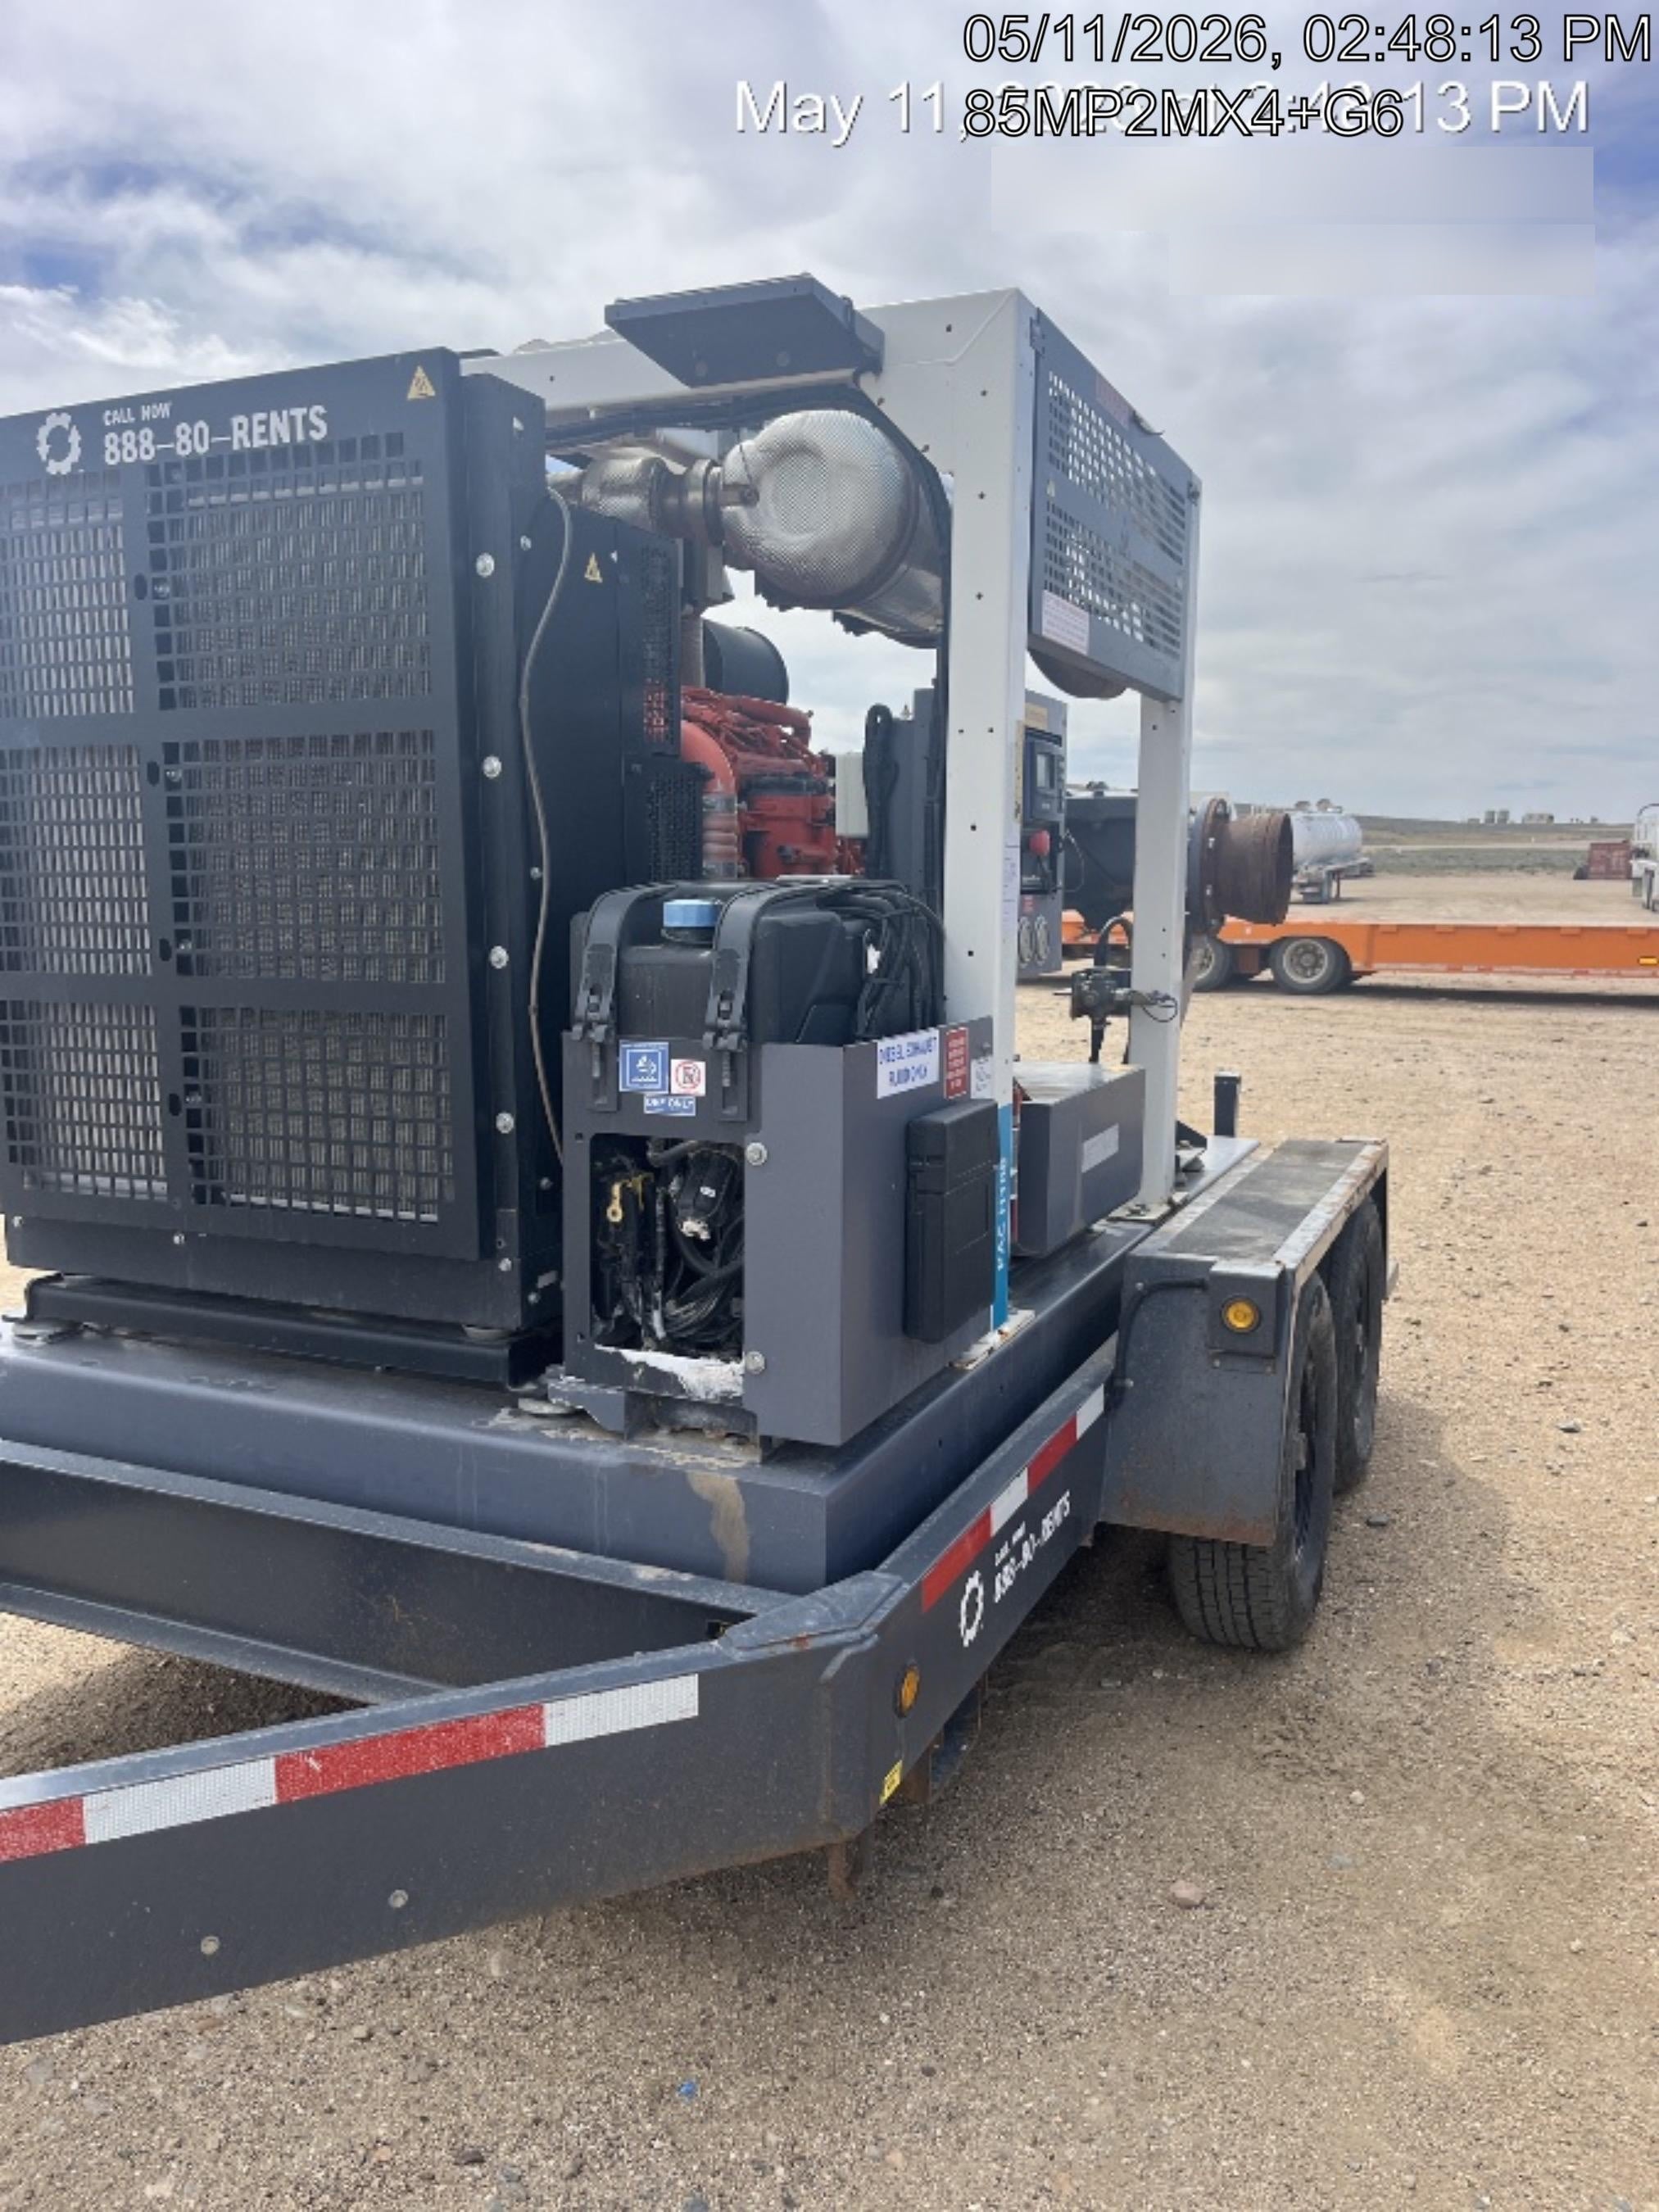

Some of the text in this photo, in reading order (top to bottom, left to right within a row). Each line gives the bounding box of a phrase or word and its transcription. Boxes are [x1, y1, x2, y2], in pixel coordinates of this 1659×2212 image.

[103, 402, 172, 427] CALL NOW
[104, 405, 328, 466] 888-80-RENTS
